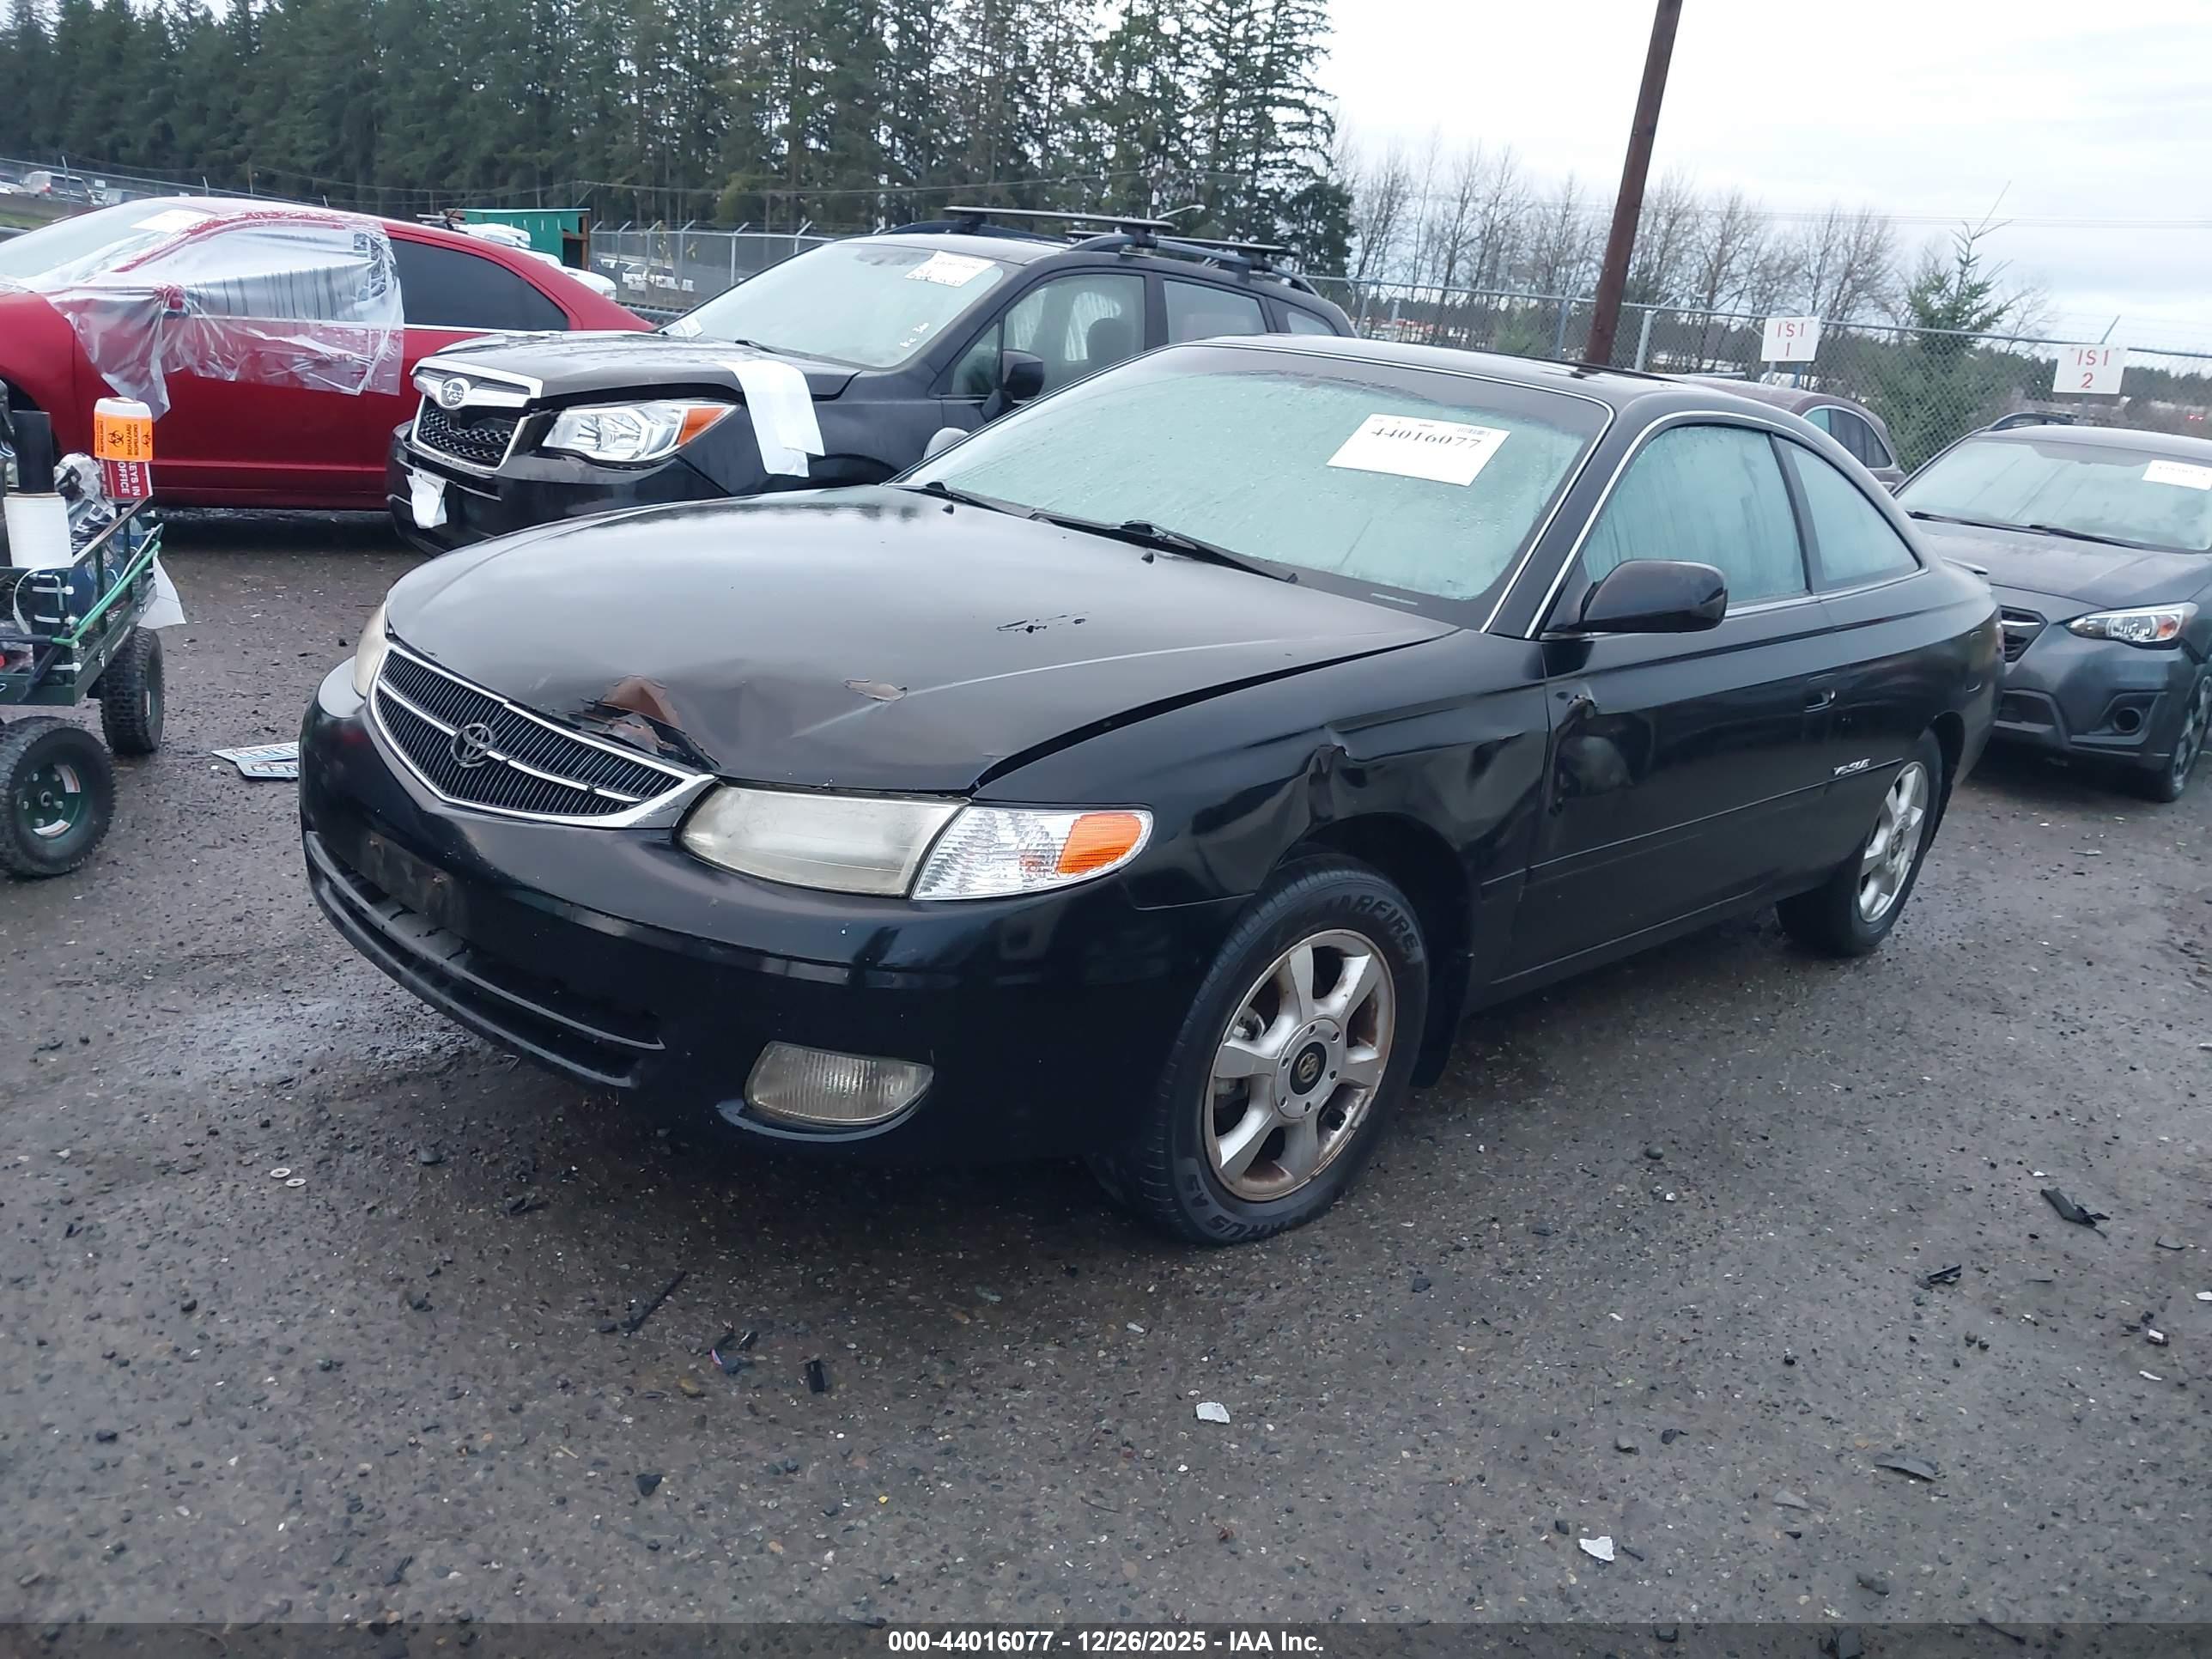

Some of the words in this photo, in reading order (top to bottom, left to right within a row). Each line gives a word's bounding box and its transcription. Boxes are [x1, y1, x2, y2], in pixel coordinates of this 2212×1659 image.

[2081, 372, 2094, 389] 2
[1370, 428, 1482, 448] 44016077
[118, 462, 131, 495] OFFICE
[132, 486, 142, 496] IN
